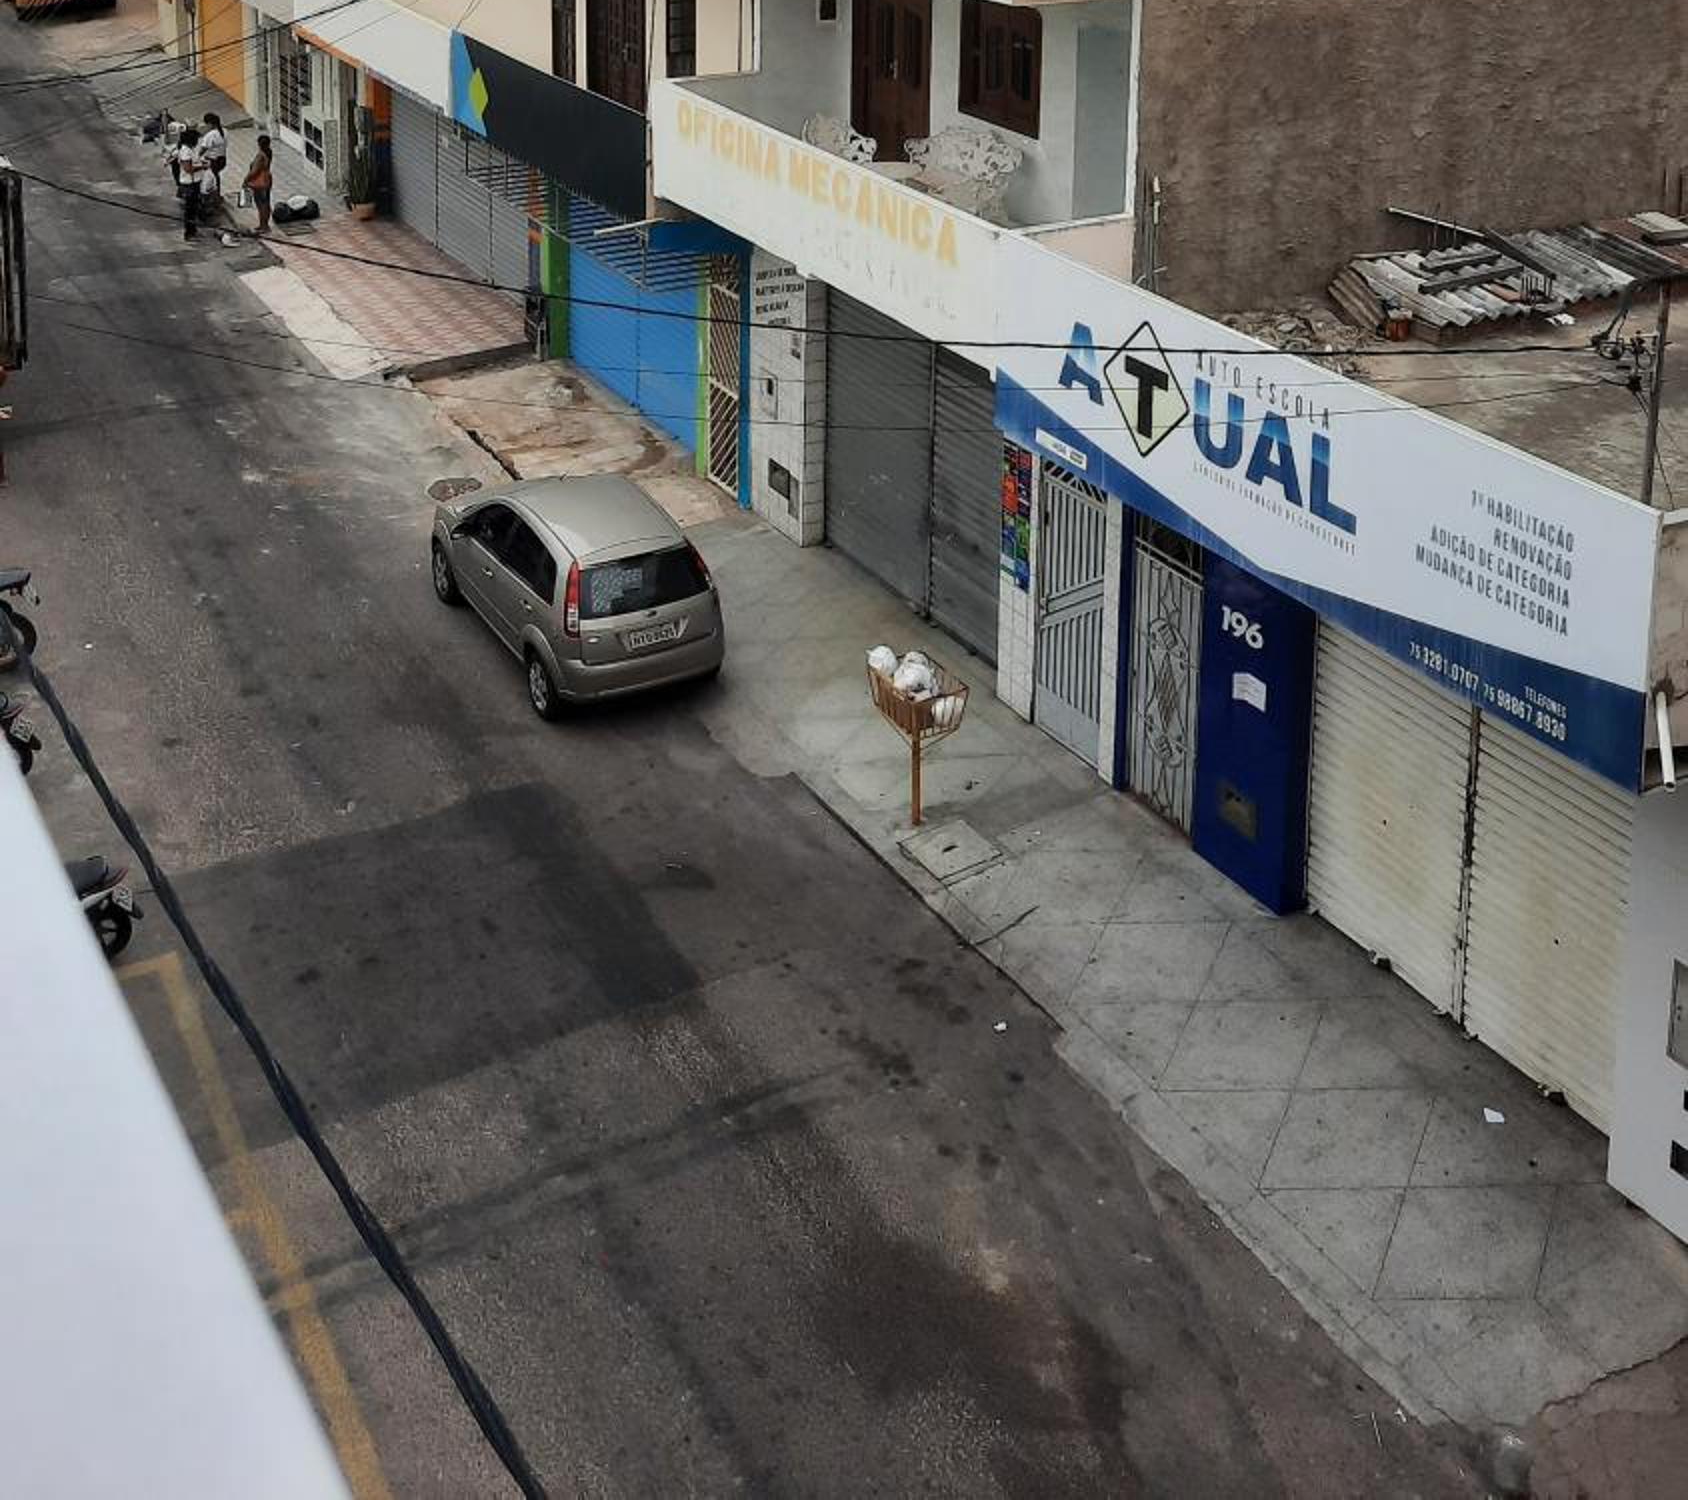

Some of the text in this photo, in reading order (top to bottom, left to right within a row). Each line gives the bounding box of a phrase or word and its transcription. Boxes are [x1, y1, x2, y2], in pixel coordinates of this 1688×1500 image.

[676, 98, 780, 182] OFICINA
[1194, 351, 1330, 431] AUTO ESCOLA
[1487, 497, 1574, 553] HABILITAÇÃO
[1494, 528, 1572, 581] RENOVAÇÃO
[1416, 543, 1568, 637] MUDANÇA DE CATEGORIA
[1430, 524, 1569, 609] ADIÇÃO DE CATEGORIA
[1221, 604, 1264, 649] 196
